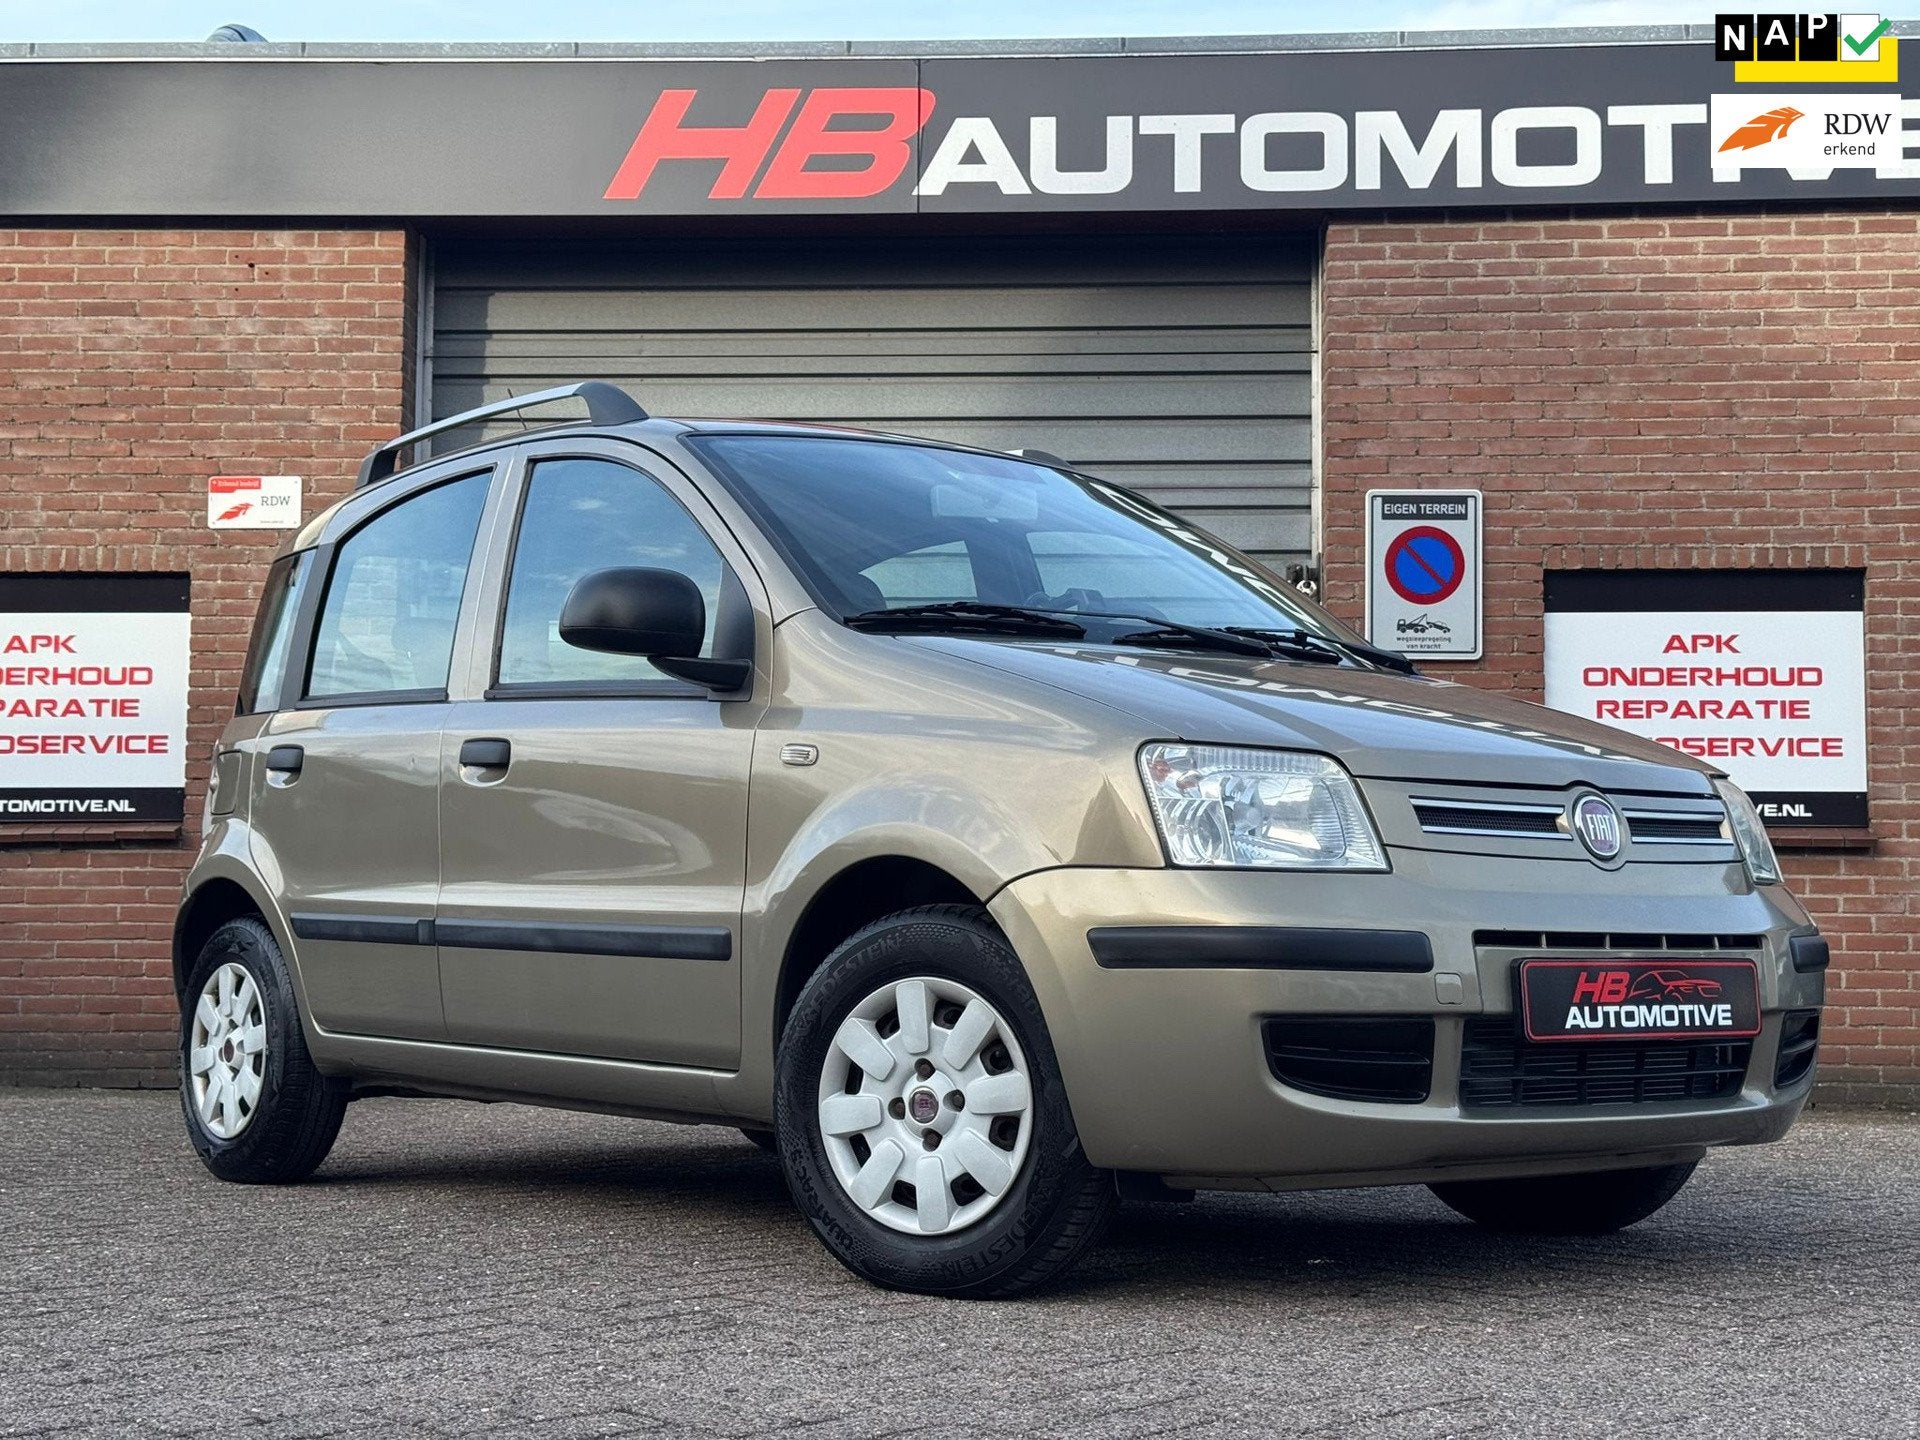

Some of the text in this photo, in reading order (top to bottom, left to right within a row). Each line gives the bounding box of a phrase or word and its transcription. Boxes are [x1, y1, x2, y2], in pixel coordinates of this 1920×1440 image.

[603, 88, 1920, 199] HB AUTOMOT
[261, 496, 291, 506] RDW
[1384, 504, 1466, 514] EIGEN TERREIN
[4, 635, 77, 653] APK
[1663, 634, 1740, 653] APK
[0, 667, 152, 686] ERHOUD
[1583, 667, 1823, 686] ONDERHOUD
[0, 699, 140, 718] ARATIE
[1596, 700, 1810, 719] REPARATIE
[1585, 814, 1612, 841] FIAT
[1572, 971, 1631, 1004] HB
[1565, 1004, 1733, 1029] AUTOMOTIVE
